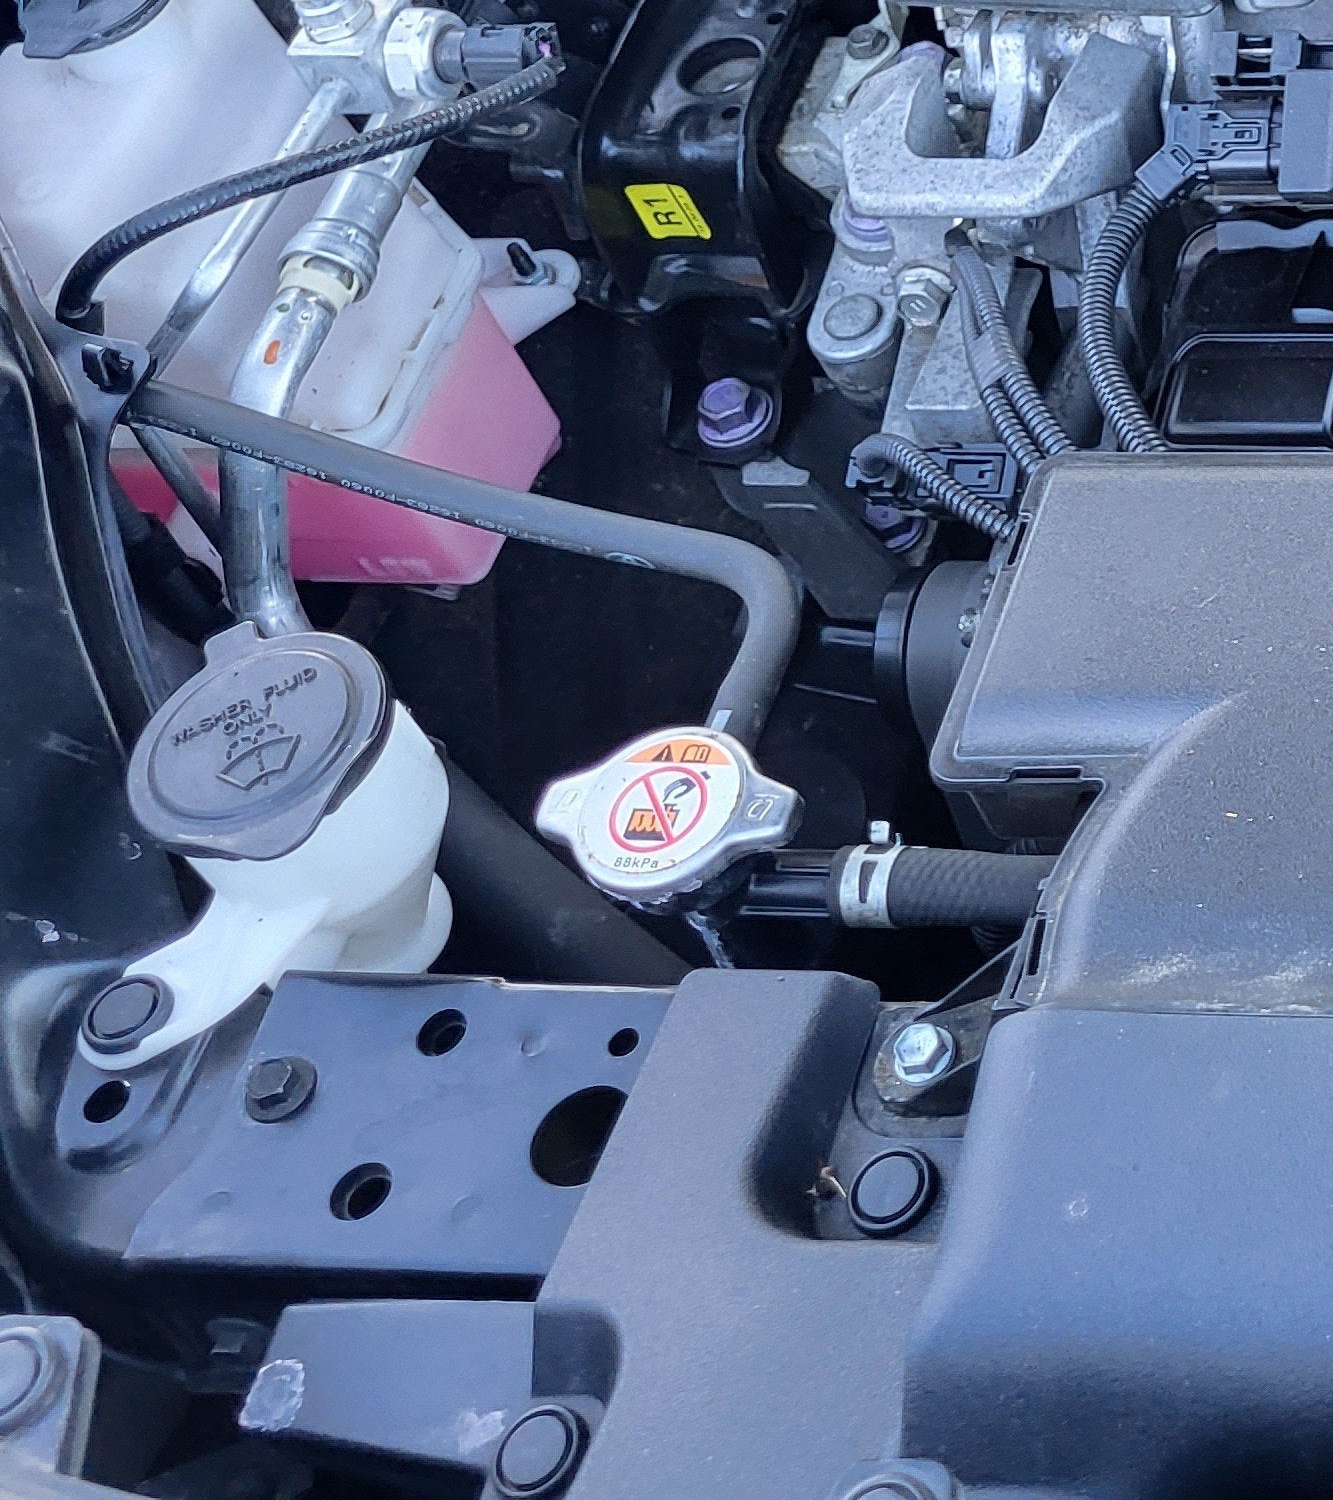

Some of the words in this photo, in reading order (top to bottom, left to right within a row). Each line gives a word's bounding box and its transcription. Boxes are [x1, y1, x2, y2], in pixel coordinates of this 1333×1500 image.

[642, 197, 683, 226] R1
[263, 667, 318, 700] FLUID
[223, 703, 273, 736] ONLY
[613, 856, 659, 870] 88kPa
